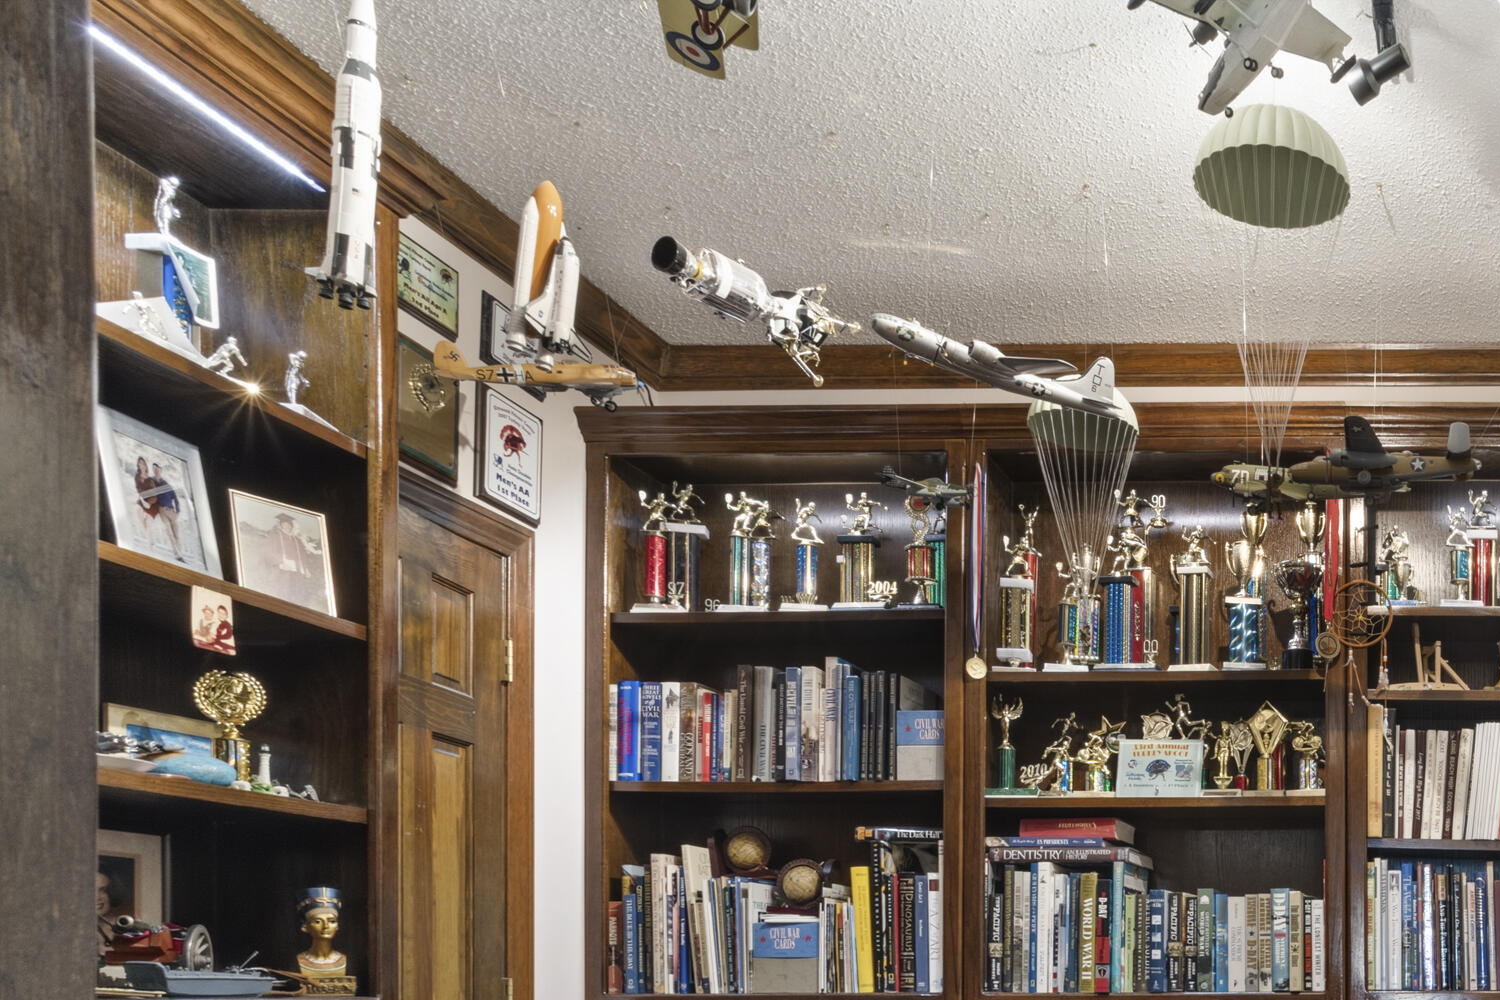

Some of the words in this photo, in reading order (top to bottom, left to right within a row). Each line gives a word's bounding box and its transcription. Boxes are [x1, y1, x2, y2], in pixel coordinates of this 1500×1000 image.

[496, 472, 517, 490] Men's
[519, 485, 530, 497] AA
[511, 489, 530, 507] Place
[1151, 494, 1166, 509] 90
[668, 581, 685, 596] 97
[867, 580, 899, 596] 2004
[914, 719, 931, 729] CIVIL
[759, 740, 767, 758] CIVIL
[759, 760, 767, 777] WAR
[1020, 763, 1047, 779] 2010
[1003, 849, 1063, 861] DENTISTRY
[1098, 897, 1109, 919] D-DAY
[1273, 893, 1288, 931] D-DAY
[993, 907, 1002, 942] PACIFIC
[1082, 898, 1094, 940] WORLD
[1171, 907, 1181, 941] PACIFIC
[769, 927, 787, 939] CIVIL
[787, 927, 802, 938] WAR
[1186, 911, 1196, 945] PACIFIC
[774, 938, 796, 949] CARDS
[1082, 943, 1094, 968] WAR
[1082, 971, 1092, 981] II
